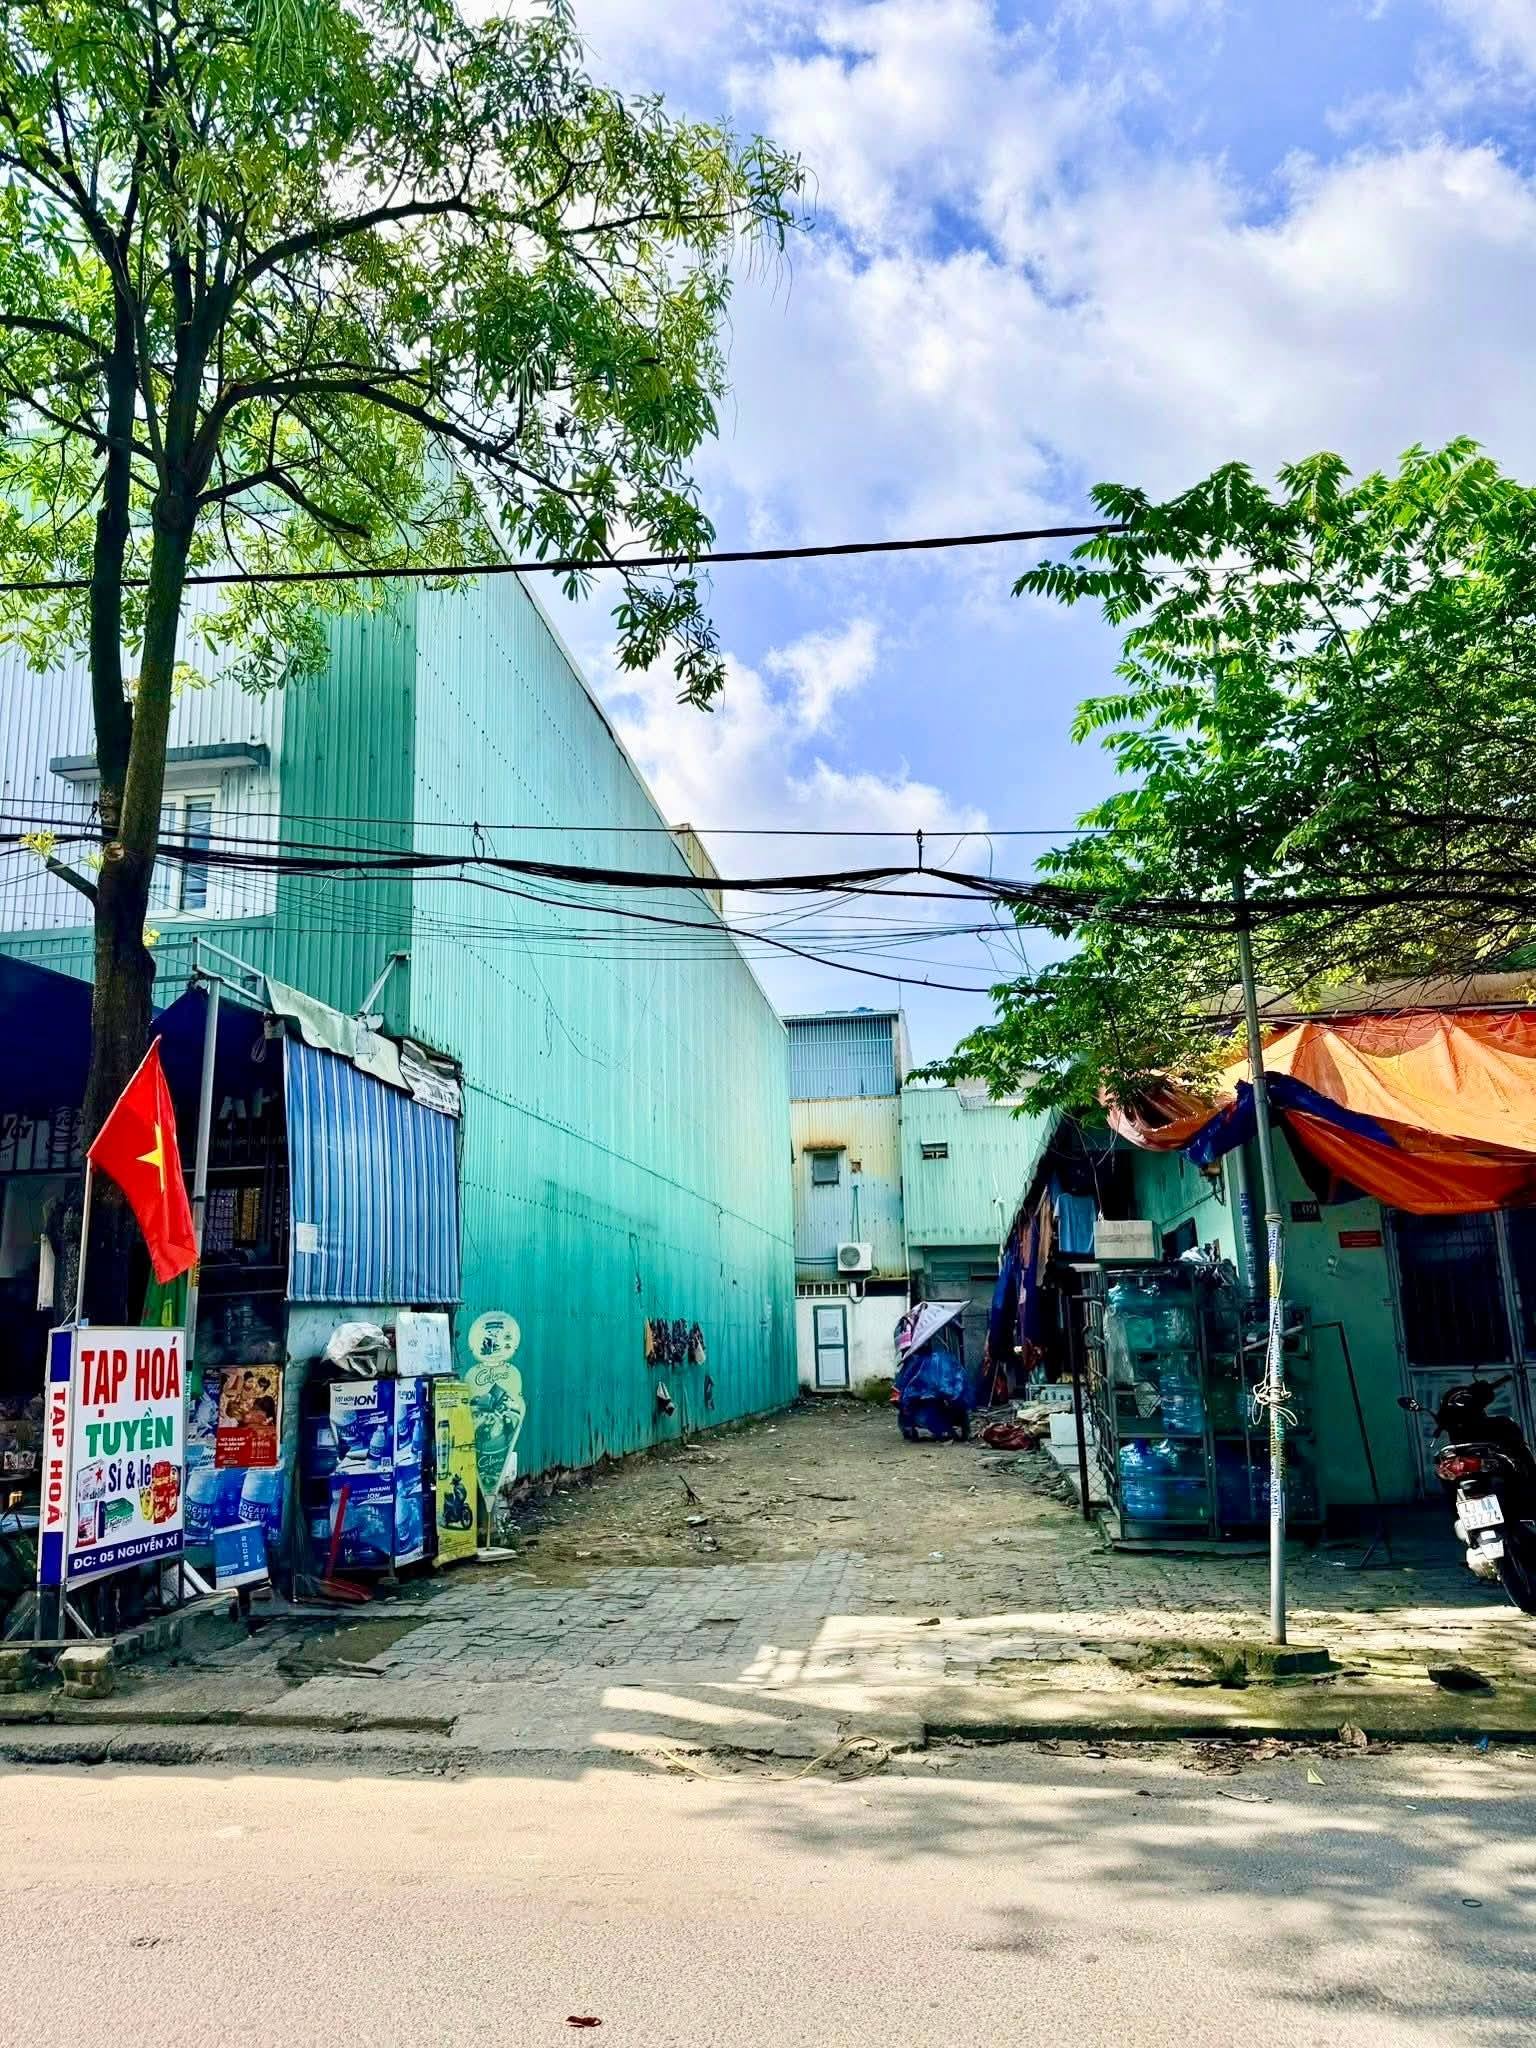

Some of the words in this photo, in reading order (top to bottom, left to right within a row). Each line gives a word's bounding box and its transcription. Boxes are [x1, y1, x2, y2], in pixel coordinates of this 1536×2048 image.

[81, 1349, 128, 1418] TẠP
[134, 1336, 180, 1402] HOÁ
[49, 1387, 66, 1448] TẠP
[353, 1394, 377, 1406] ION
[85, 1407, 175, 1458] TUYỀN
[126, 1460, 136, 1490] &
[73, 1555, 96, 1570] ĐC:
[100, 1550, 114, 1563] 05
[117, 1536, 163, 1559] NGUYỄN
[166, 1532, 179, 1548] XÍ
